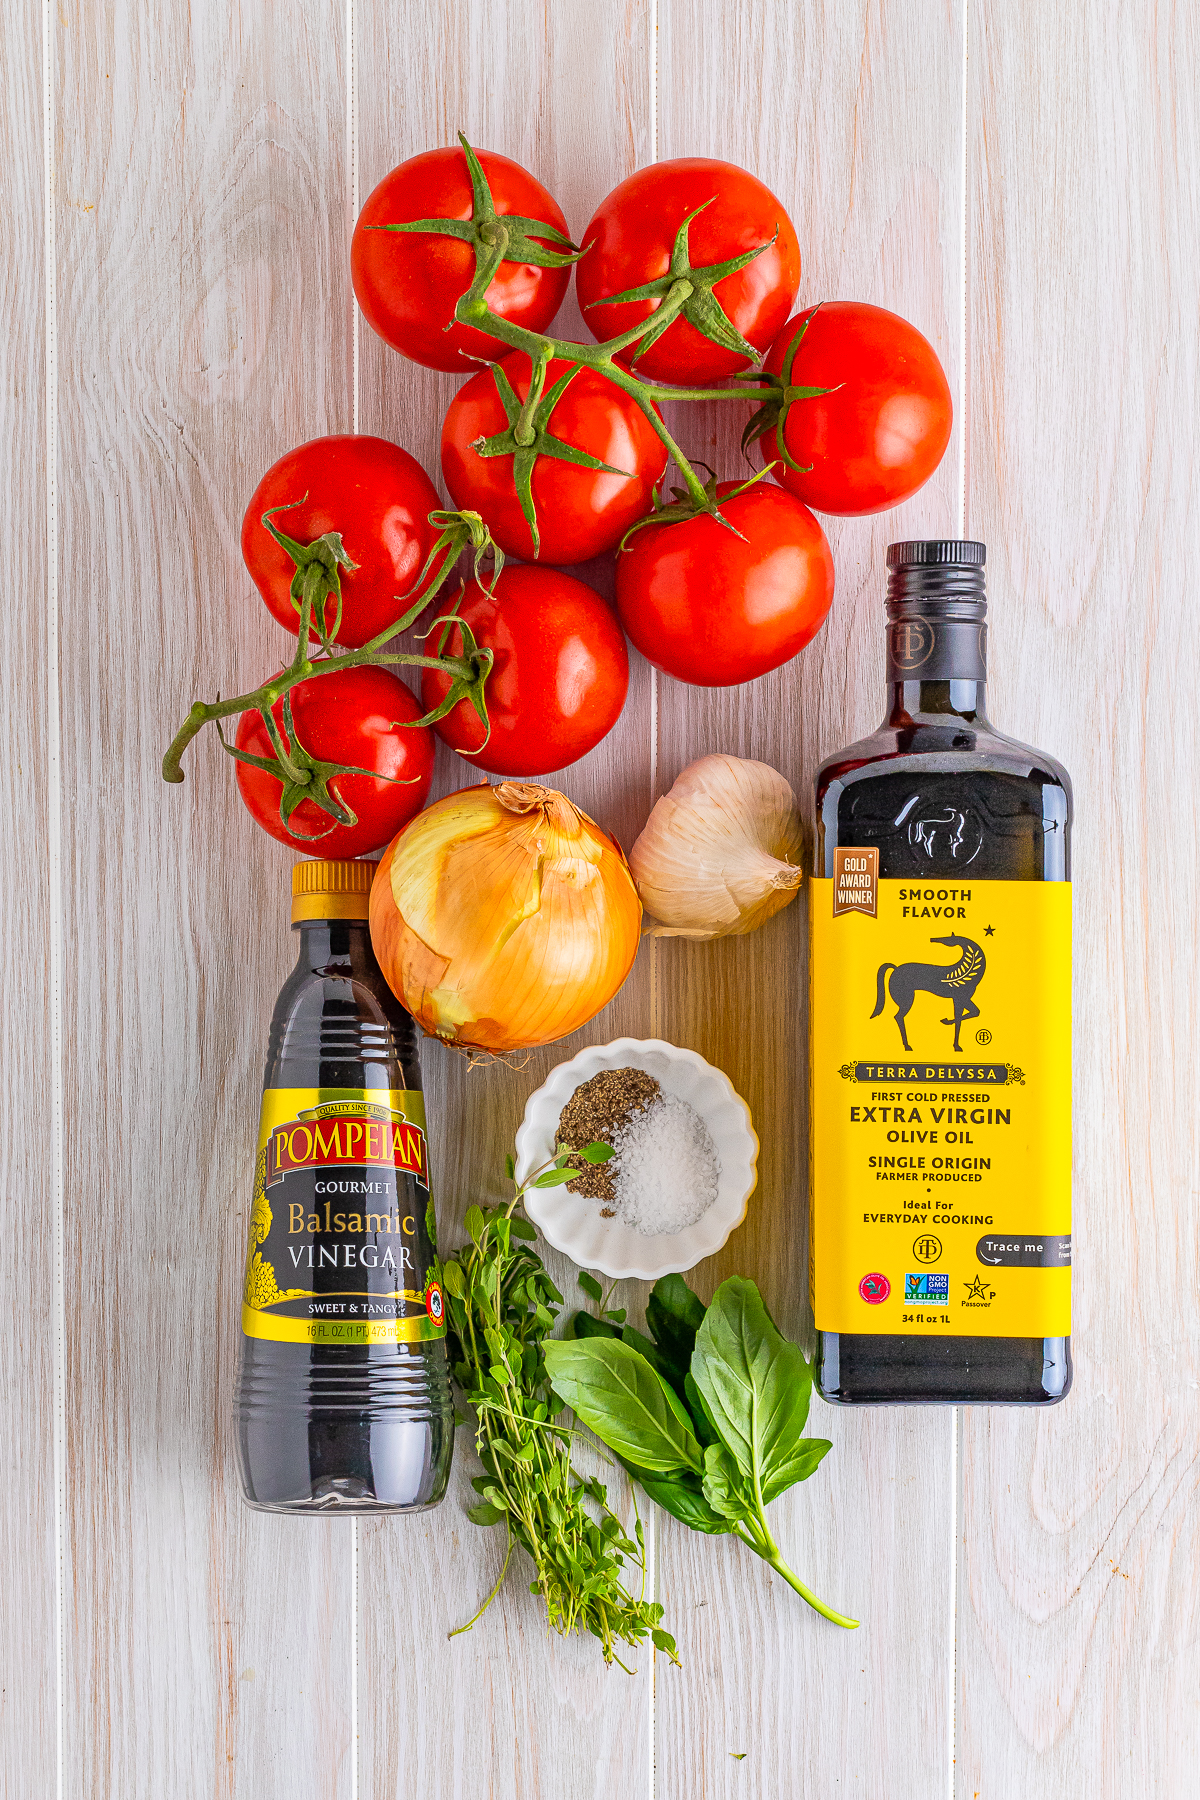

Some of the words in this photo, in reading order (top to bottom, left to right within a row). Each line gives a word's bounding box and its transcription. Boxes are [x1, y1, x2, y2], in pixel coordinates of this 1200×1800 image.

[844, 857, 867, 872] GOLD
[839, 874, 871, 888] AWARD
[837, 890, 873, 904] WINNER
[898, 888, 972, 902] SMOOTH
[902, 906, 967, 919] FLAVOR
[866, 1066, 919, 1079] TERRA
[925, 1067, 997, 1080] DELYSSA
[871, 1092, 903, 1102] FIRST
[906, 1092, 938, 1103] COLD
[941, 1093, 990, 1103] PRESSED
[319, 1104, 350, 1115] QUALITY
[351, 1103, 372, 1111] SINCE
[850, 1106, 923, 1124] EXTRA
[930, 1108, 1011, 1125] VIRGIN
[886, 1130, 938, 1143] OLIVE
[944, 1131, 974, 1144] OIL
[274, 1120, 423, 1170] POMPEIAN
[868, 1156, 926, 1169] SINGLE
[931, 1157, 991, 1170] ORIGIN
[876, 1172, 919, 1181] FARMER
[922, 1172, 983, 1182] PRODUCED
[314, 1181, 392, 1195] GOURMET
[903, 1200, 932, 1210] Ideal
[935, 1201, 954, 1210] For
[287, 1201, 416, 1236] Balsamic
[863, 1214, 928, 1224] EVERYDAY
[932, 1215, 994, 1225] COOKING
[985, 1241, 1020, 1252] Trace
[1024, 1244, 1044, 1252] me
[287, 1244, 415, 1270] VINEGAR
[973, 1285, 981, 1293] K
[989, 1291, 996, 1300] P
[308, 1303, 347, 1314] SWEET
[349, 1303, 359, 1313] &
[360, 1303, 398, 1314] TANGY
[961, 1300, 991, 1308] Passover
[902, 1314, 914, 1323] 34
[916, 1314, 924, 1323] fl
[940, 1315, 950, 1324] 1L
[306, 1325, 317, 1337] 16
[346, 1325, 353, 1338] (1
[371, 1325, 387, 1337] 473
[388, 1325, 400, 1337] mL
